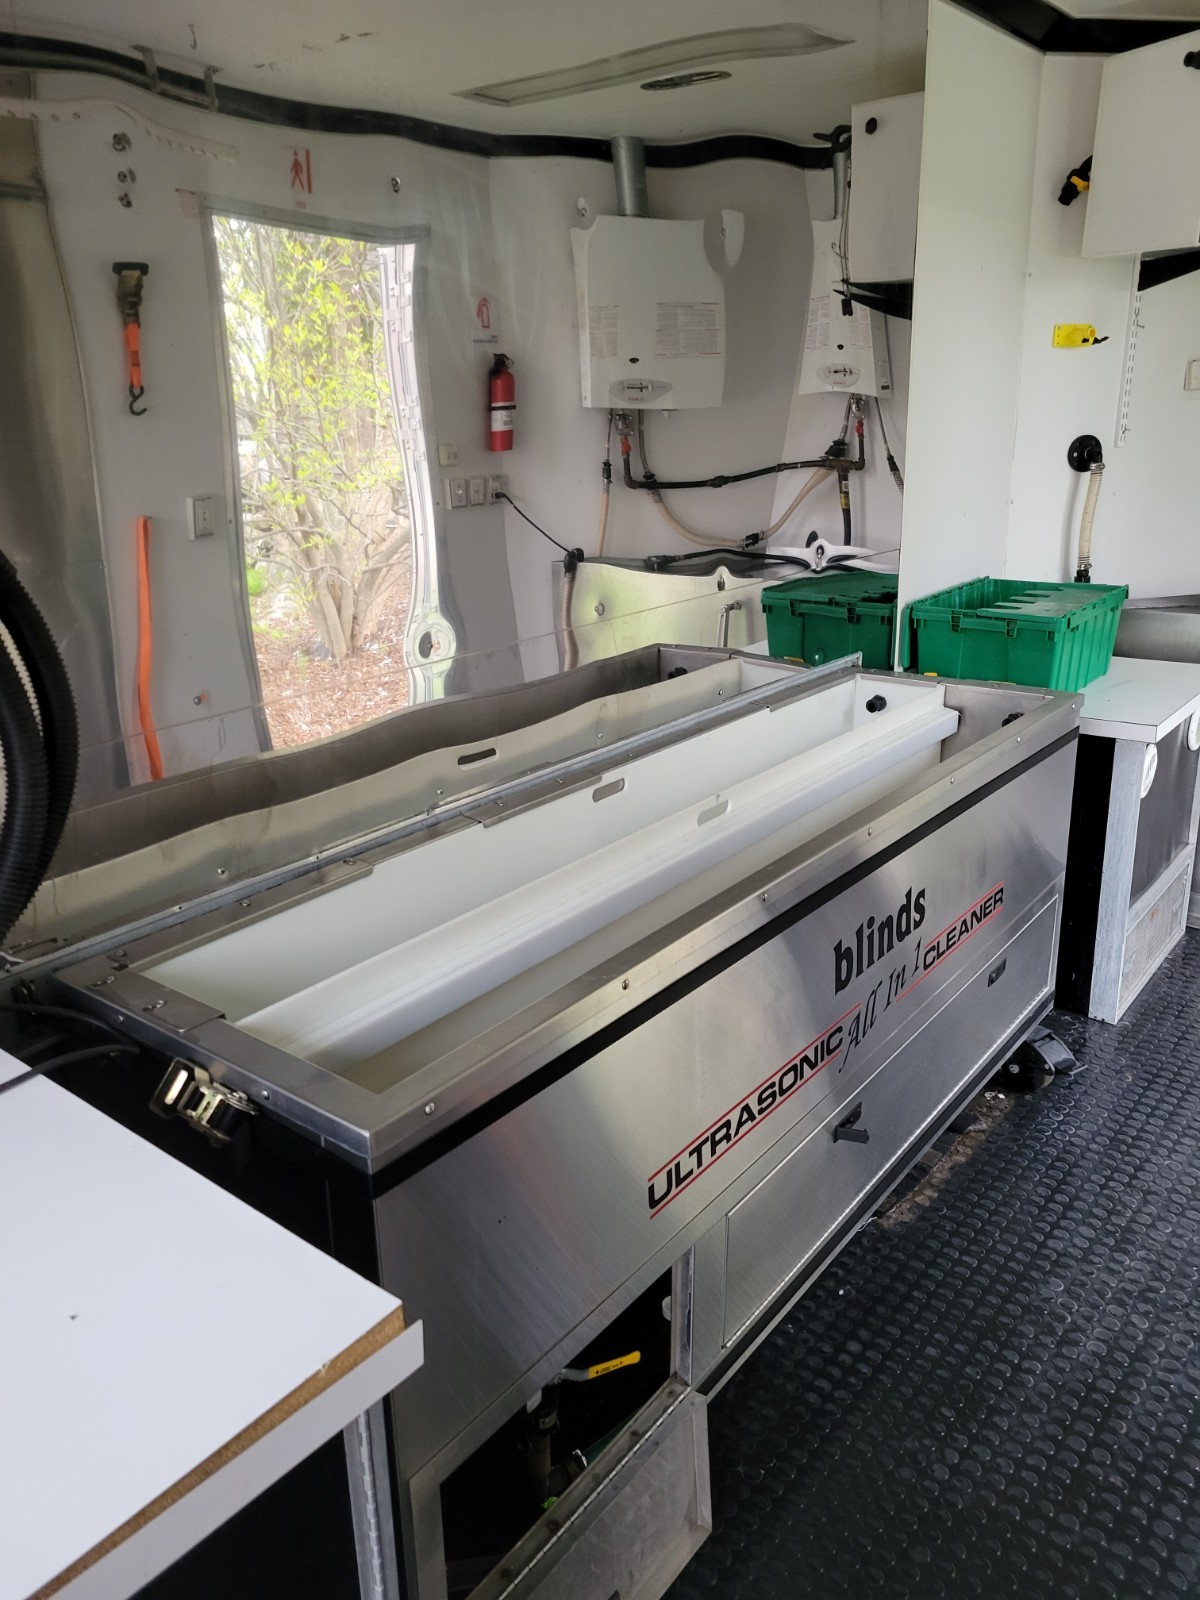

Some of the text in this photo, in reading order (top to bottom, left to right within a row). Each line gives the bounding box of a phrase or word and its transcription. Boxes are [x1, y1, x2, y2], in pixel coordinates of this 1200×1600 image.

[648, 887, 1004, 1210] ULTRASONIC All In 1 CLEANER
[834, 886, 926, 996] blinds
